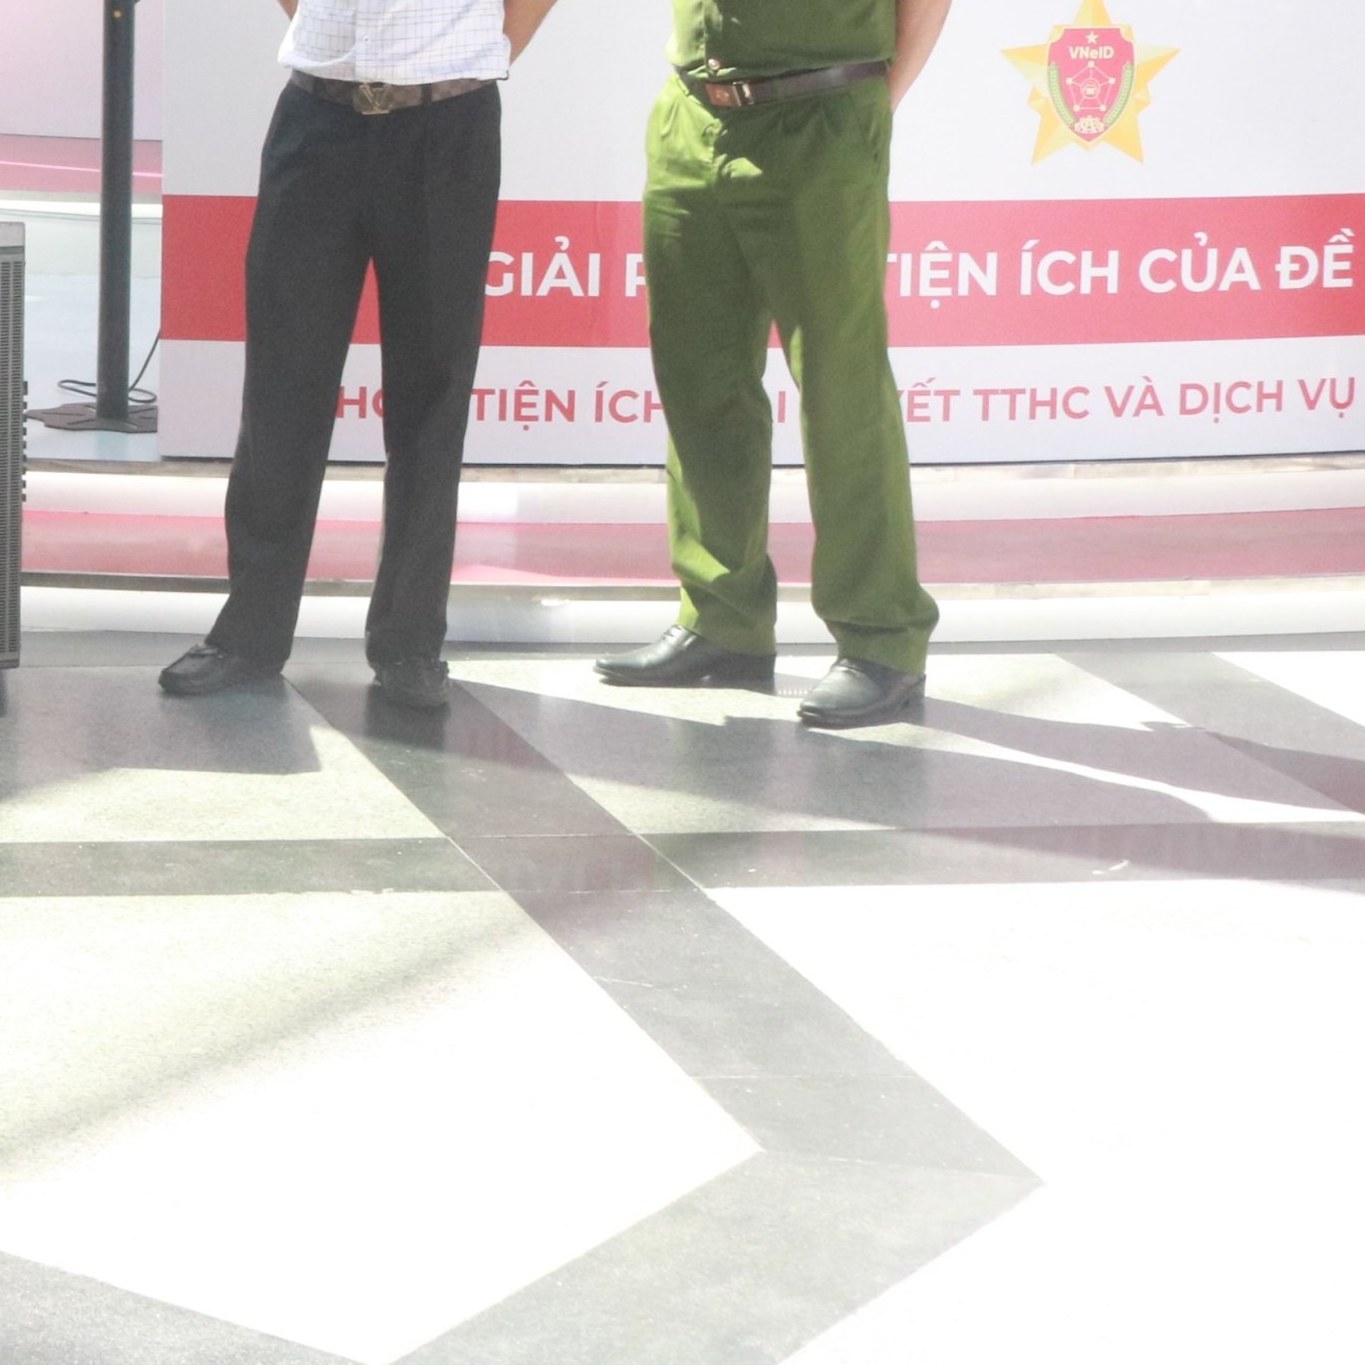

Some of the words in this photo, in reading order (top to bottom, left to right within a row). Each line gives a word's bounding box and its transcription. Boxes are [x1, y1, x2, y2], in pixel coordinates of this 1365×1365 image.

[1069, 46, 1114, 60] VNeID
[484, 236, 601, 296] GIẢI
[1020, 239, 1119, 296] ÍCH
[1139, 232, 1261, 293] CỦA
[1275, 228, 1355, 290] ĐỀ
[471, 380, 576, 431] TIỆN
[973, 386, 1090, 422] TTHC
[1104, 376, 1164, 417] VÀ
[1179, 380, 1284, 423] DỊCH
[1298, 377, 1355, 418] VỤ
